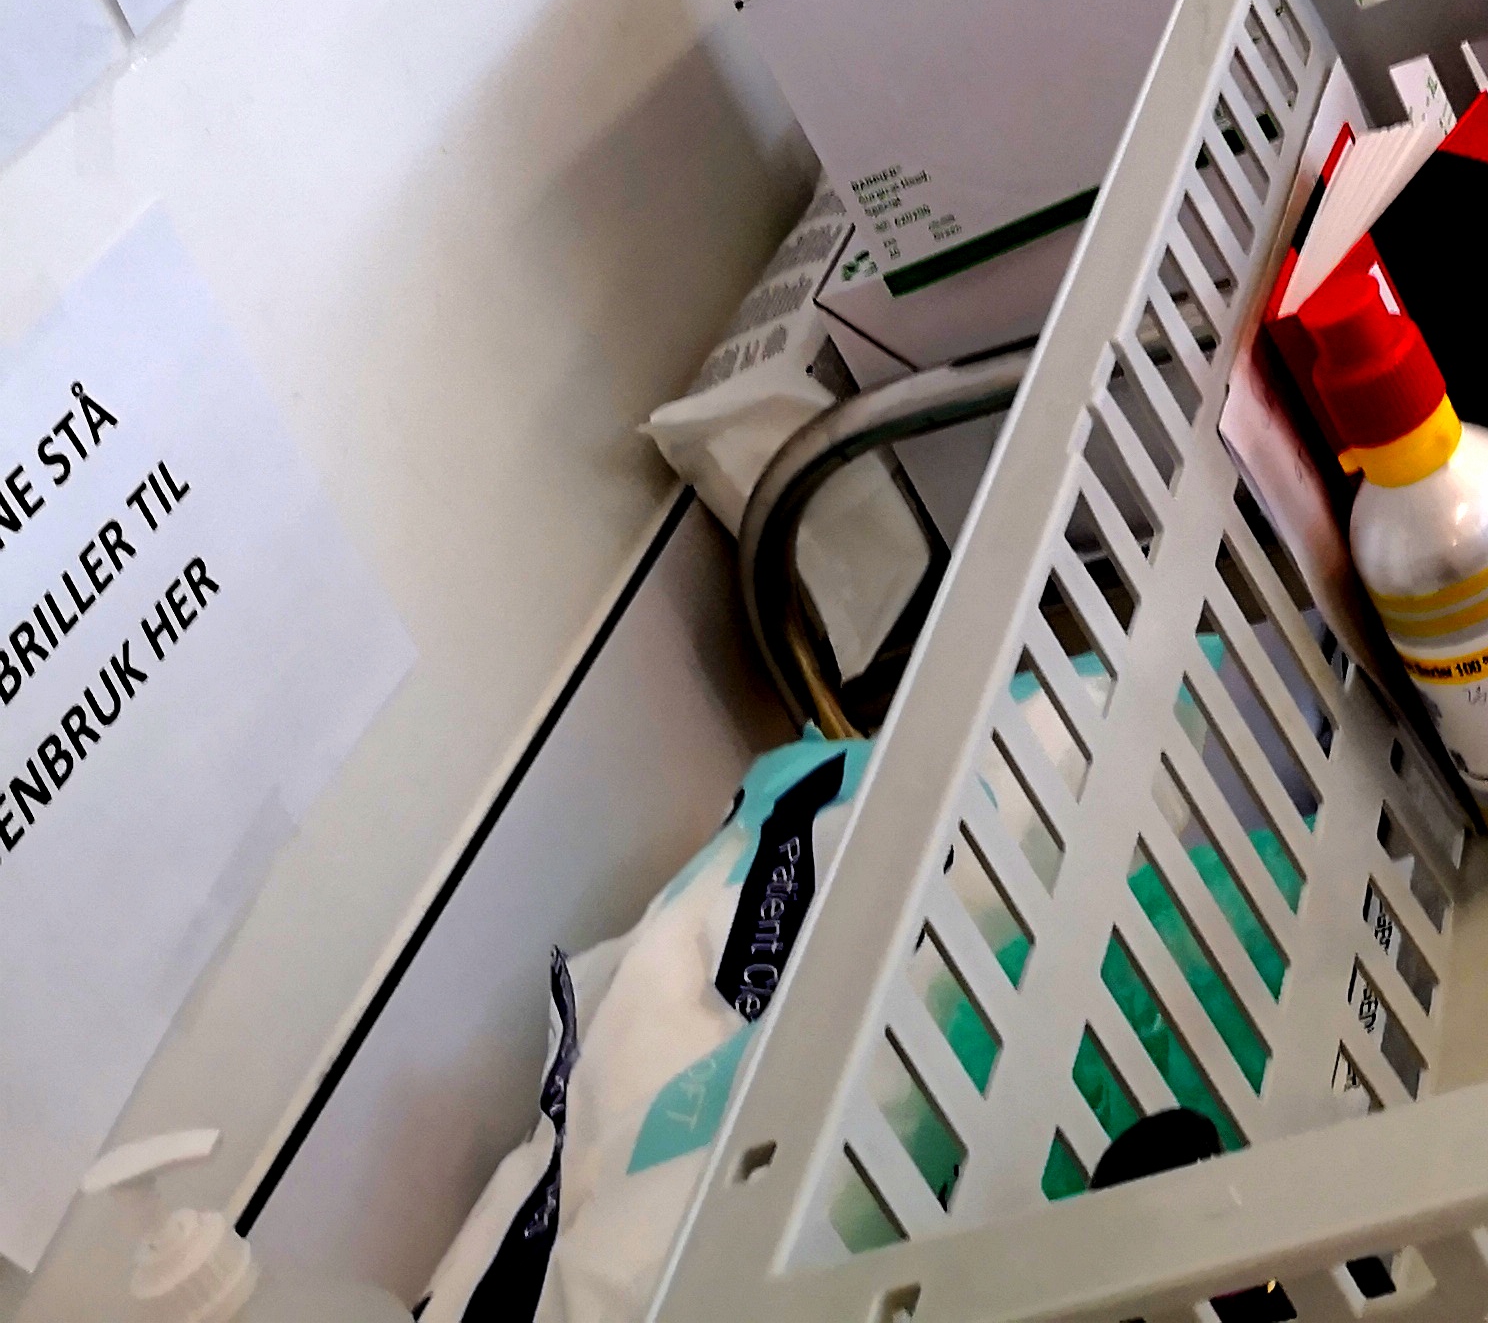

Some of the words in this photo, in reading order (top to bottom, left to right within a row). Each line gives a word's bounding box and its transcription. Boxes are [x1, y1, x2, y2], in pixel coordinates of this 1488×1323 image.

[36, 380, 119, 488] STÅ
[0, 518, 137, 706] BRILLER
[125, 459, 192, 532] TIL
[139, 555, 222, 661] HER
[749, 834, 803, 968] Patient
